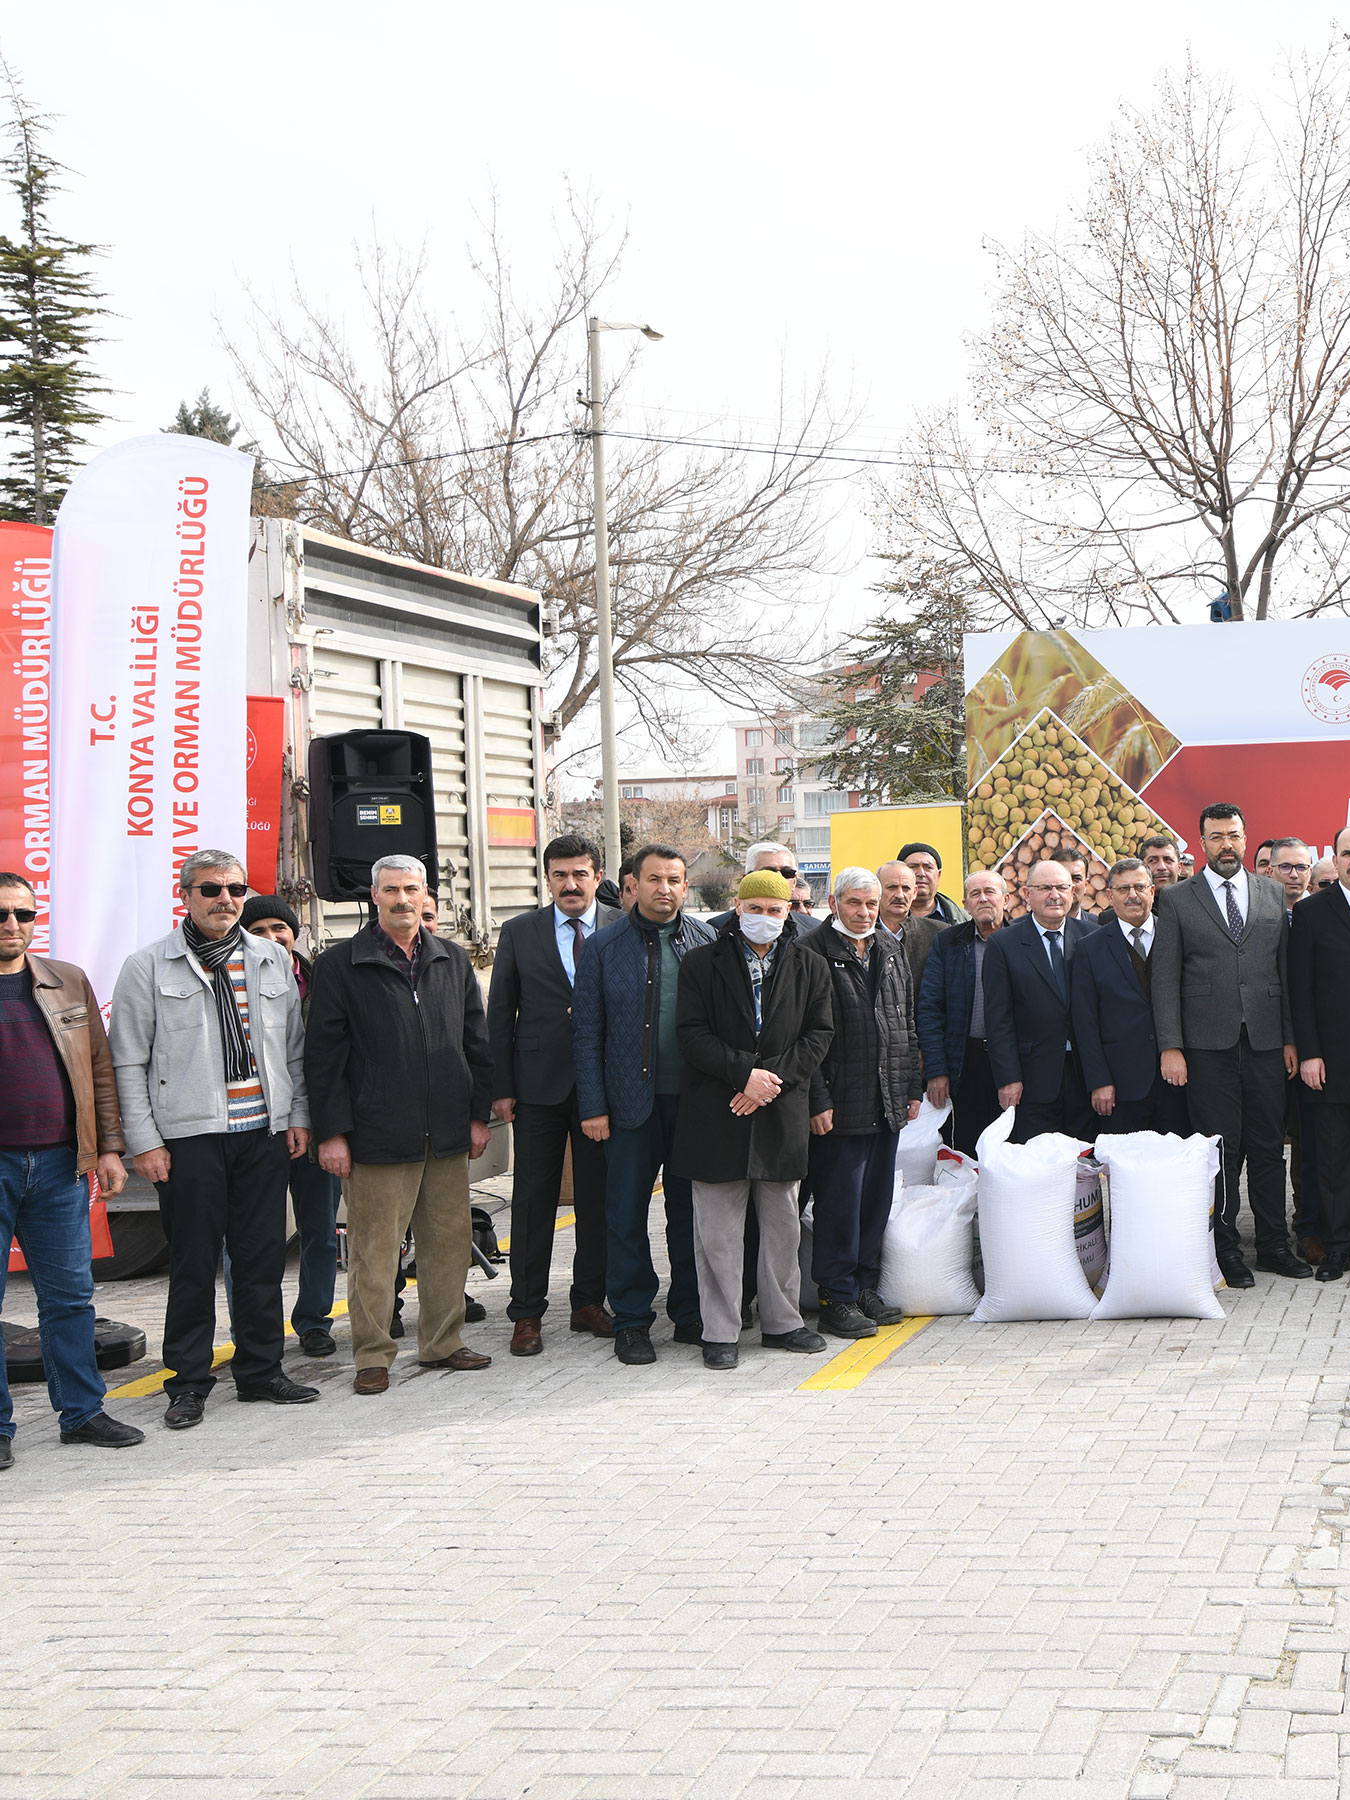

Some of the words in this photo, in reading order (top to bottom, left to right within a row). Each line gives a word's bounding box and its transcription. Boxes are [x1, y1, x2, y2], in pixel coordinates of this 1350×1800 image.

[170, 475, 209, 672] MÜDÜRLÜĞÜ
[12, 556, 51, 751] MÜDÜRLÜĞÜ
[129, 605, 160, 728] VALİLİĞİ
[90, 695, 117, 747] T.C.
[173, 681, 200, 794] ORMAN
[22, 760, 50, 873] ORMAN
[127, 734, 154, 837] KONYA
[172, 801, 198, 838] VE
